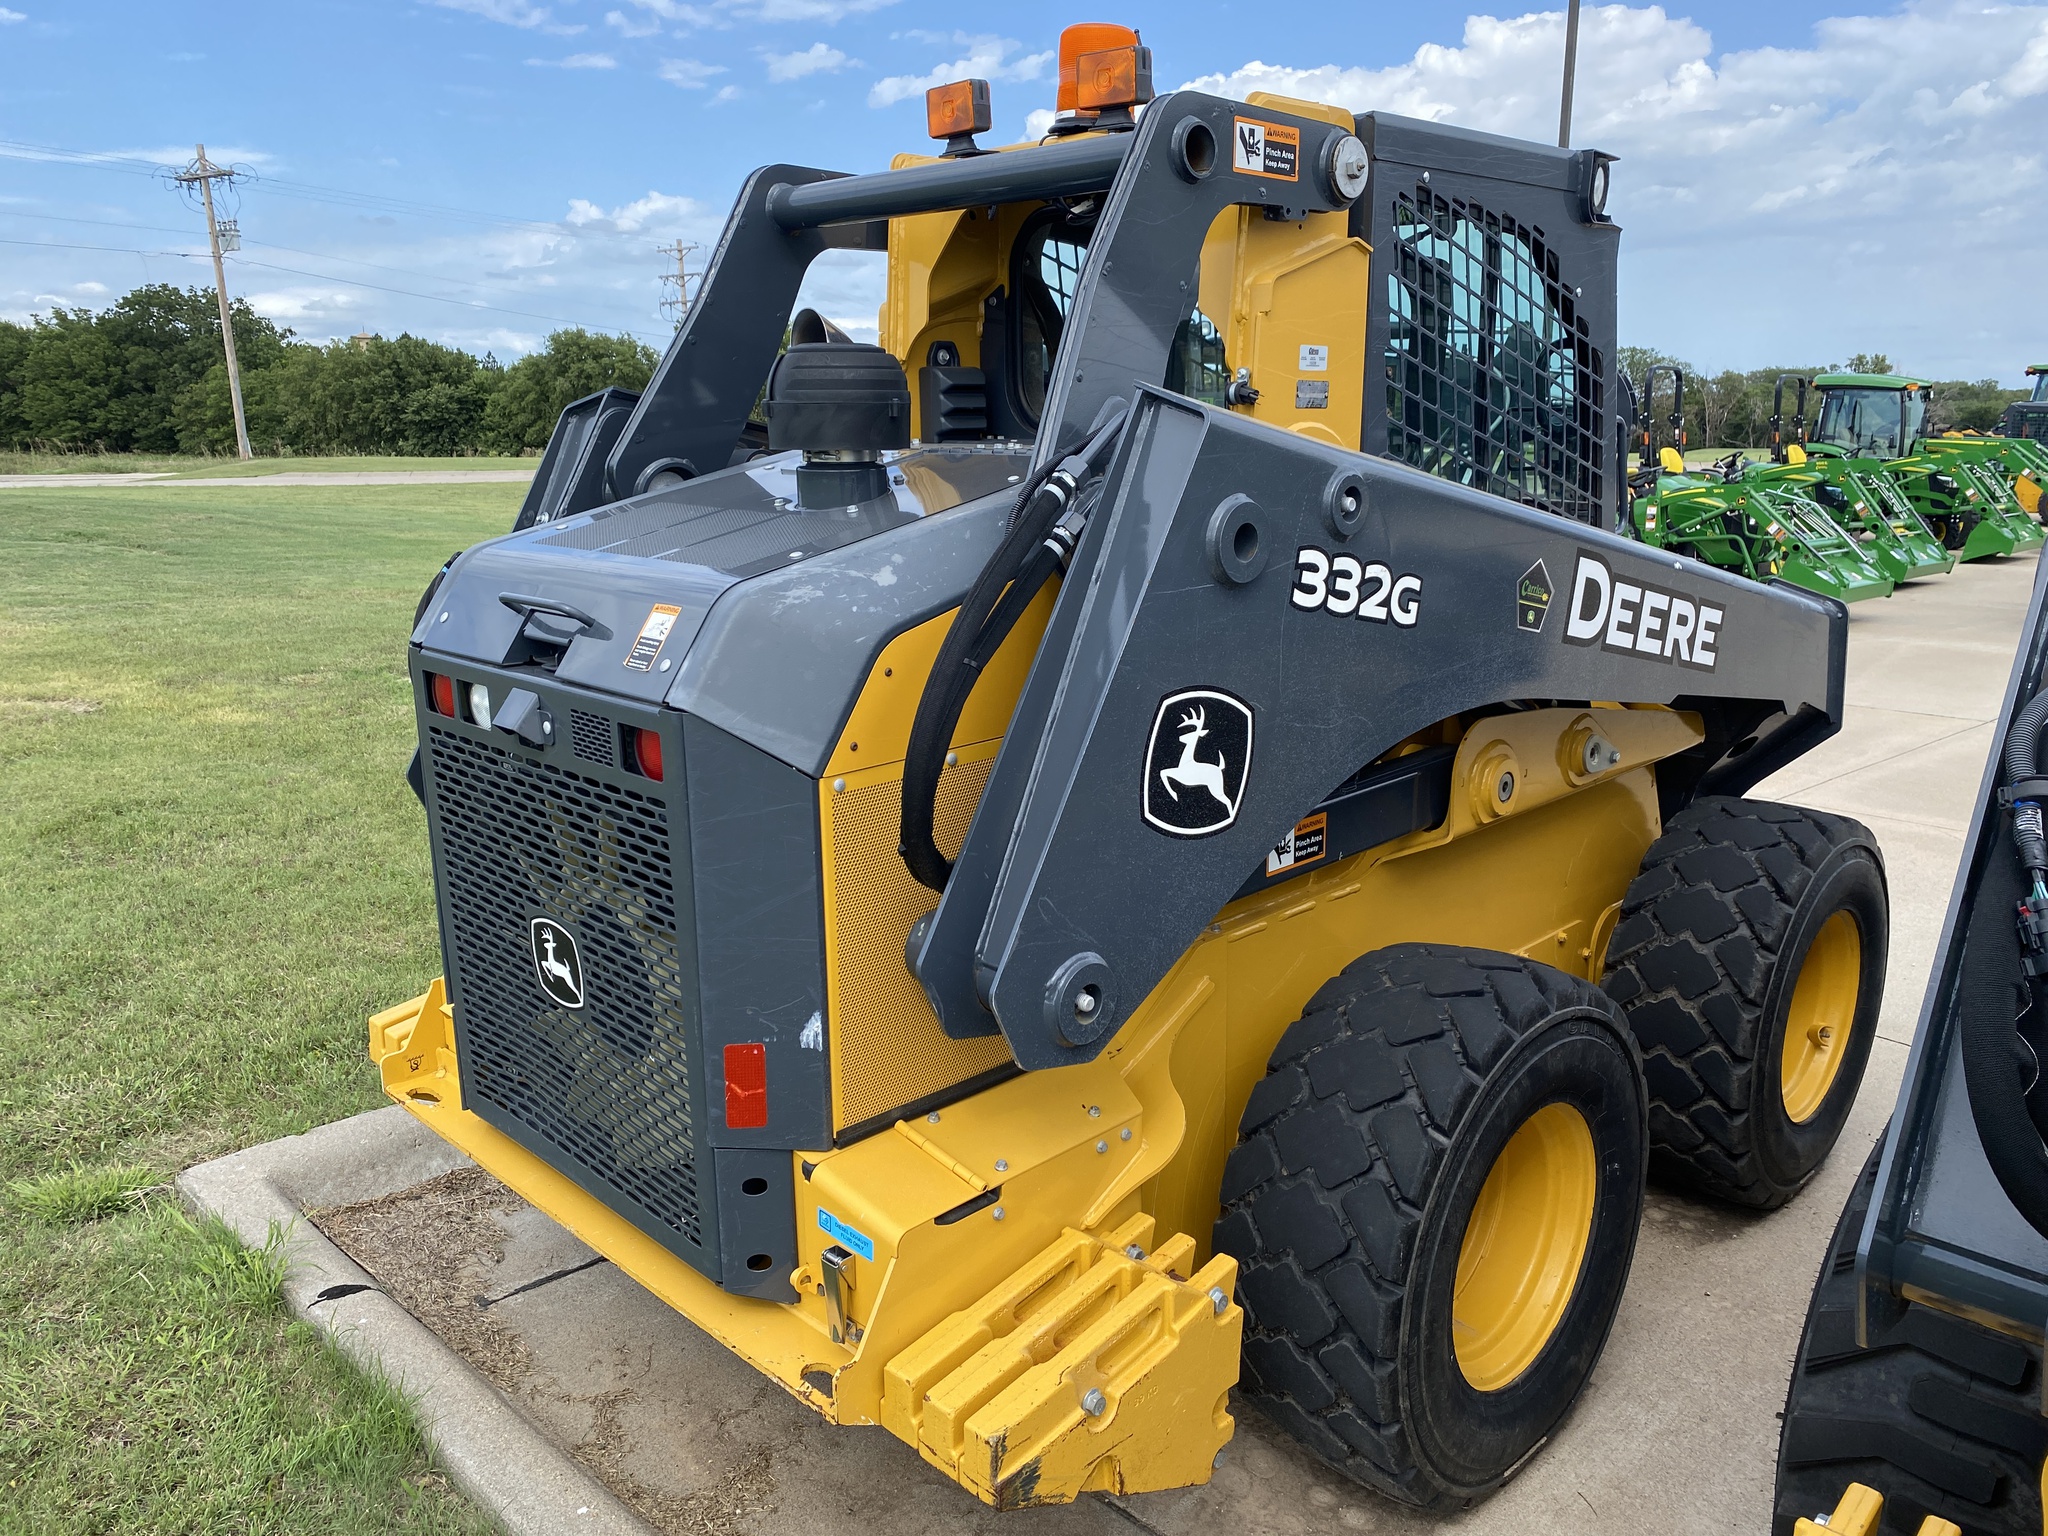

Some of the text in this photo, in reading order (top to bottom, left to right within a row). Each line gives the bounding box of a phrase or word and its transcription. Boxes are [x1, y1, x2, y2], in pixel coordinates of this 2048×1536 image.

[1272, 129, 1296, 140] WARNING
[1266, 147, 1295, 160] Pinch Area
[1265, 159, 1291, 171] Keep Away
[1292, 549, 1422, 625] 332G
[1521, 579, 1545, 597] Carrico
[1566, 556, 1724, 667] DEERE
[1301, 818, 1323, 829] WARNING
[1296, 835, 1322, 848] Pinch Area
[1295, 849, 1307, 858] Keep
[835, 1222, 869, 1248] DIESEL EXHAUST
[840, 1232, 864, 1251] FLUID ONLY
